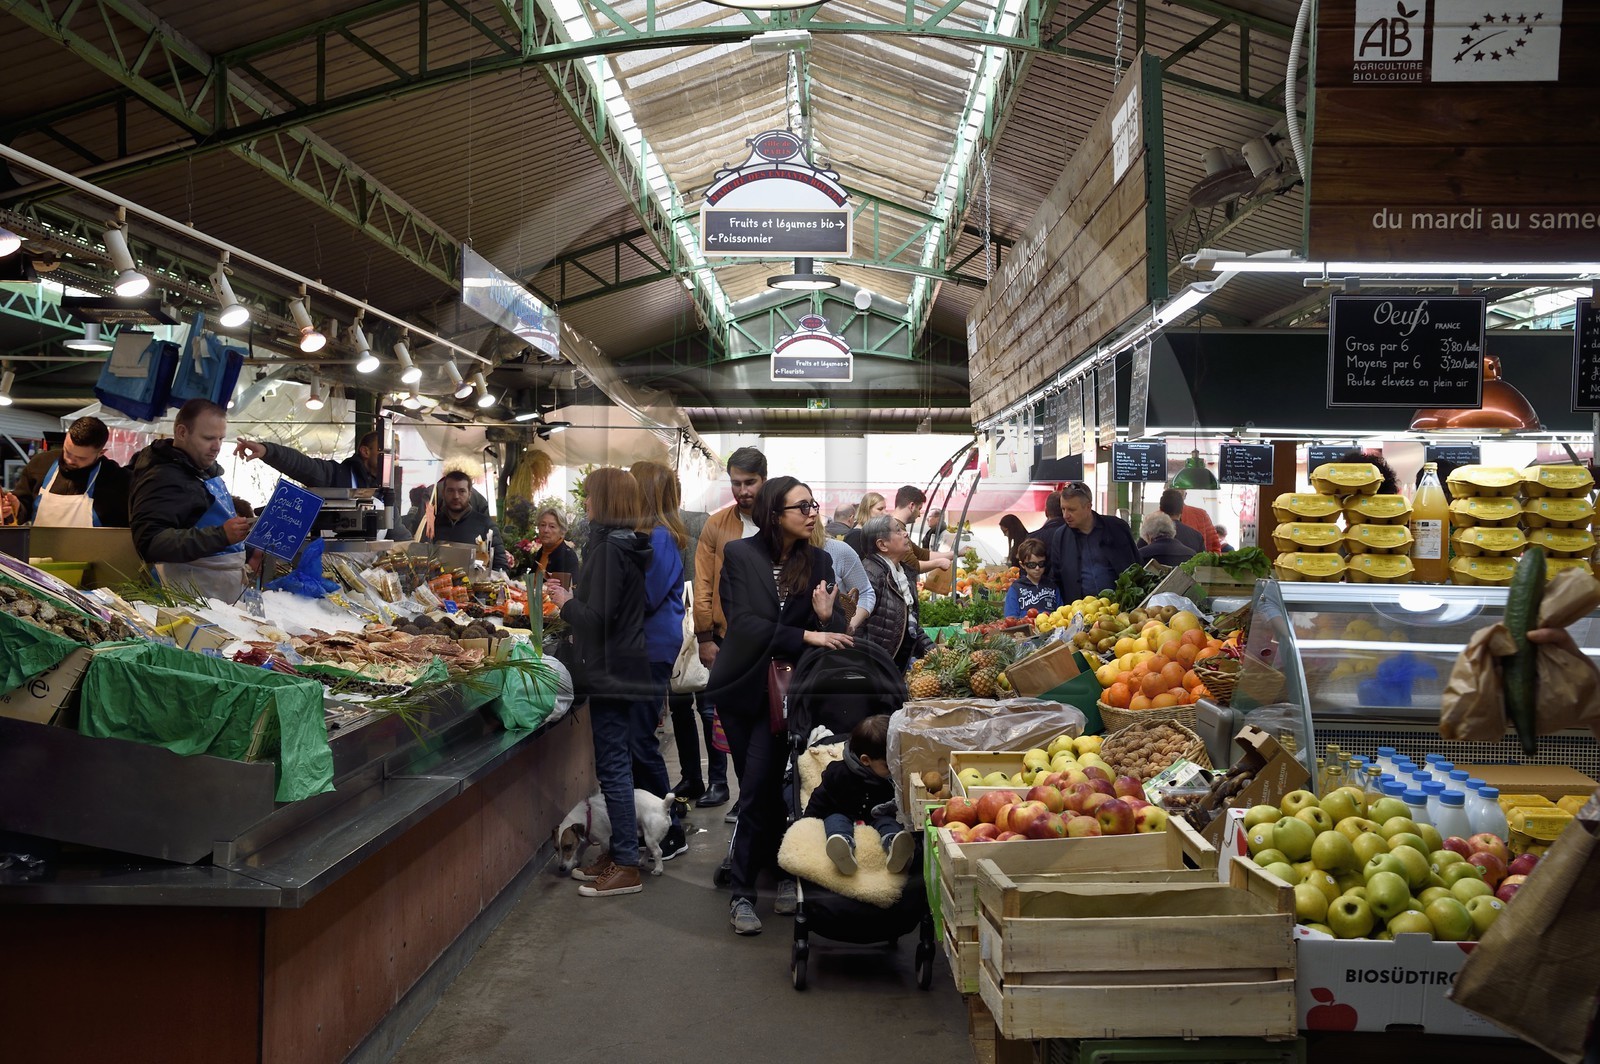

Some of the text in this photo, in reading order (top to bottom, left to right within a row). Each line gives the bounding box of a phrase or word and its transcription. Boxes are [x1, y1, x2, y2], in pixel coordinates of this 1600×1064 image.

[1359, 17, 1412, 58] AB
[1353, 62, 1423, 71] AGRICULTURE
[1353, 72, 1423, 81] BIOLOGIQUE
[748, 170, 766, 180] DES
[768, 169, 808, 182] ENFANTS
[729, 217, 835, 231] Fruits et légumes bio
[1372, 208, 1402, 229] du
[1411, 208, 1483, 229] mardi
[1491, 213, 1520, 230] au
[718, 232, 774, 244] Poissonnier
[1373, 300, 1430, 336] Oeufs
[1434, 322, 1461, 330] FRANCE
[1345, 336, 1375, 352] Gros
[1380, 342, 1398, 357] par
[1400, 339, 1409, 352] 6
[1346, 355, 1387, 374] Moyens
[1393, 360, 1409, 374] par
[1412, 355, 1421, 369] 6
[1346, 373, 1376, 387] Poules
[1381, 375, 1415, 387] élevées
[1433, 377, 1453, 393] plein
[1456, 379, 1469, 388] air
[275, 486, 304, 513] Coquilles
[1018, 588, 1055, 610] Timberland
